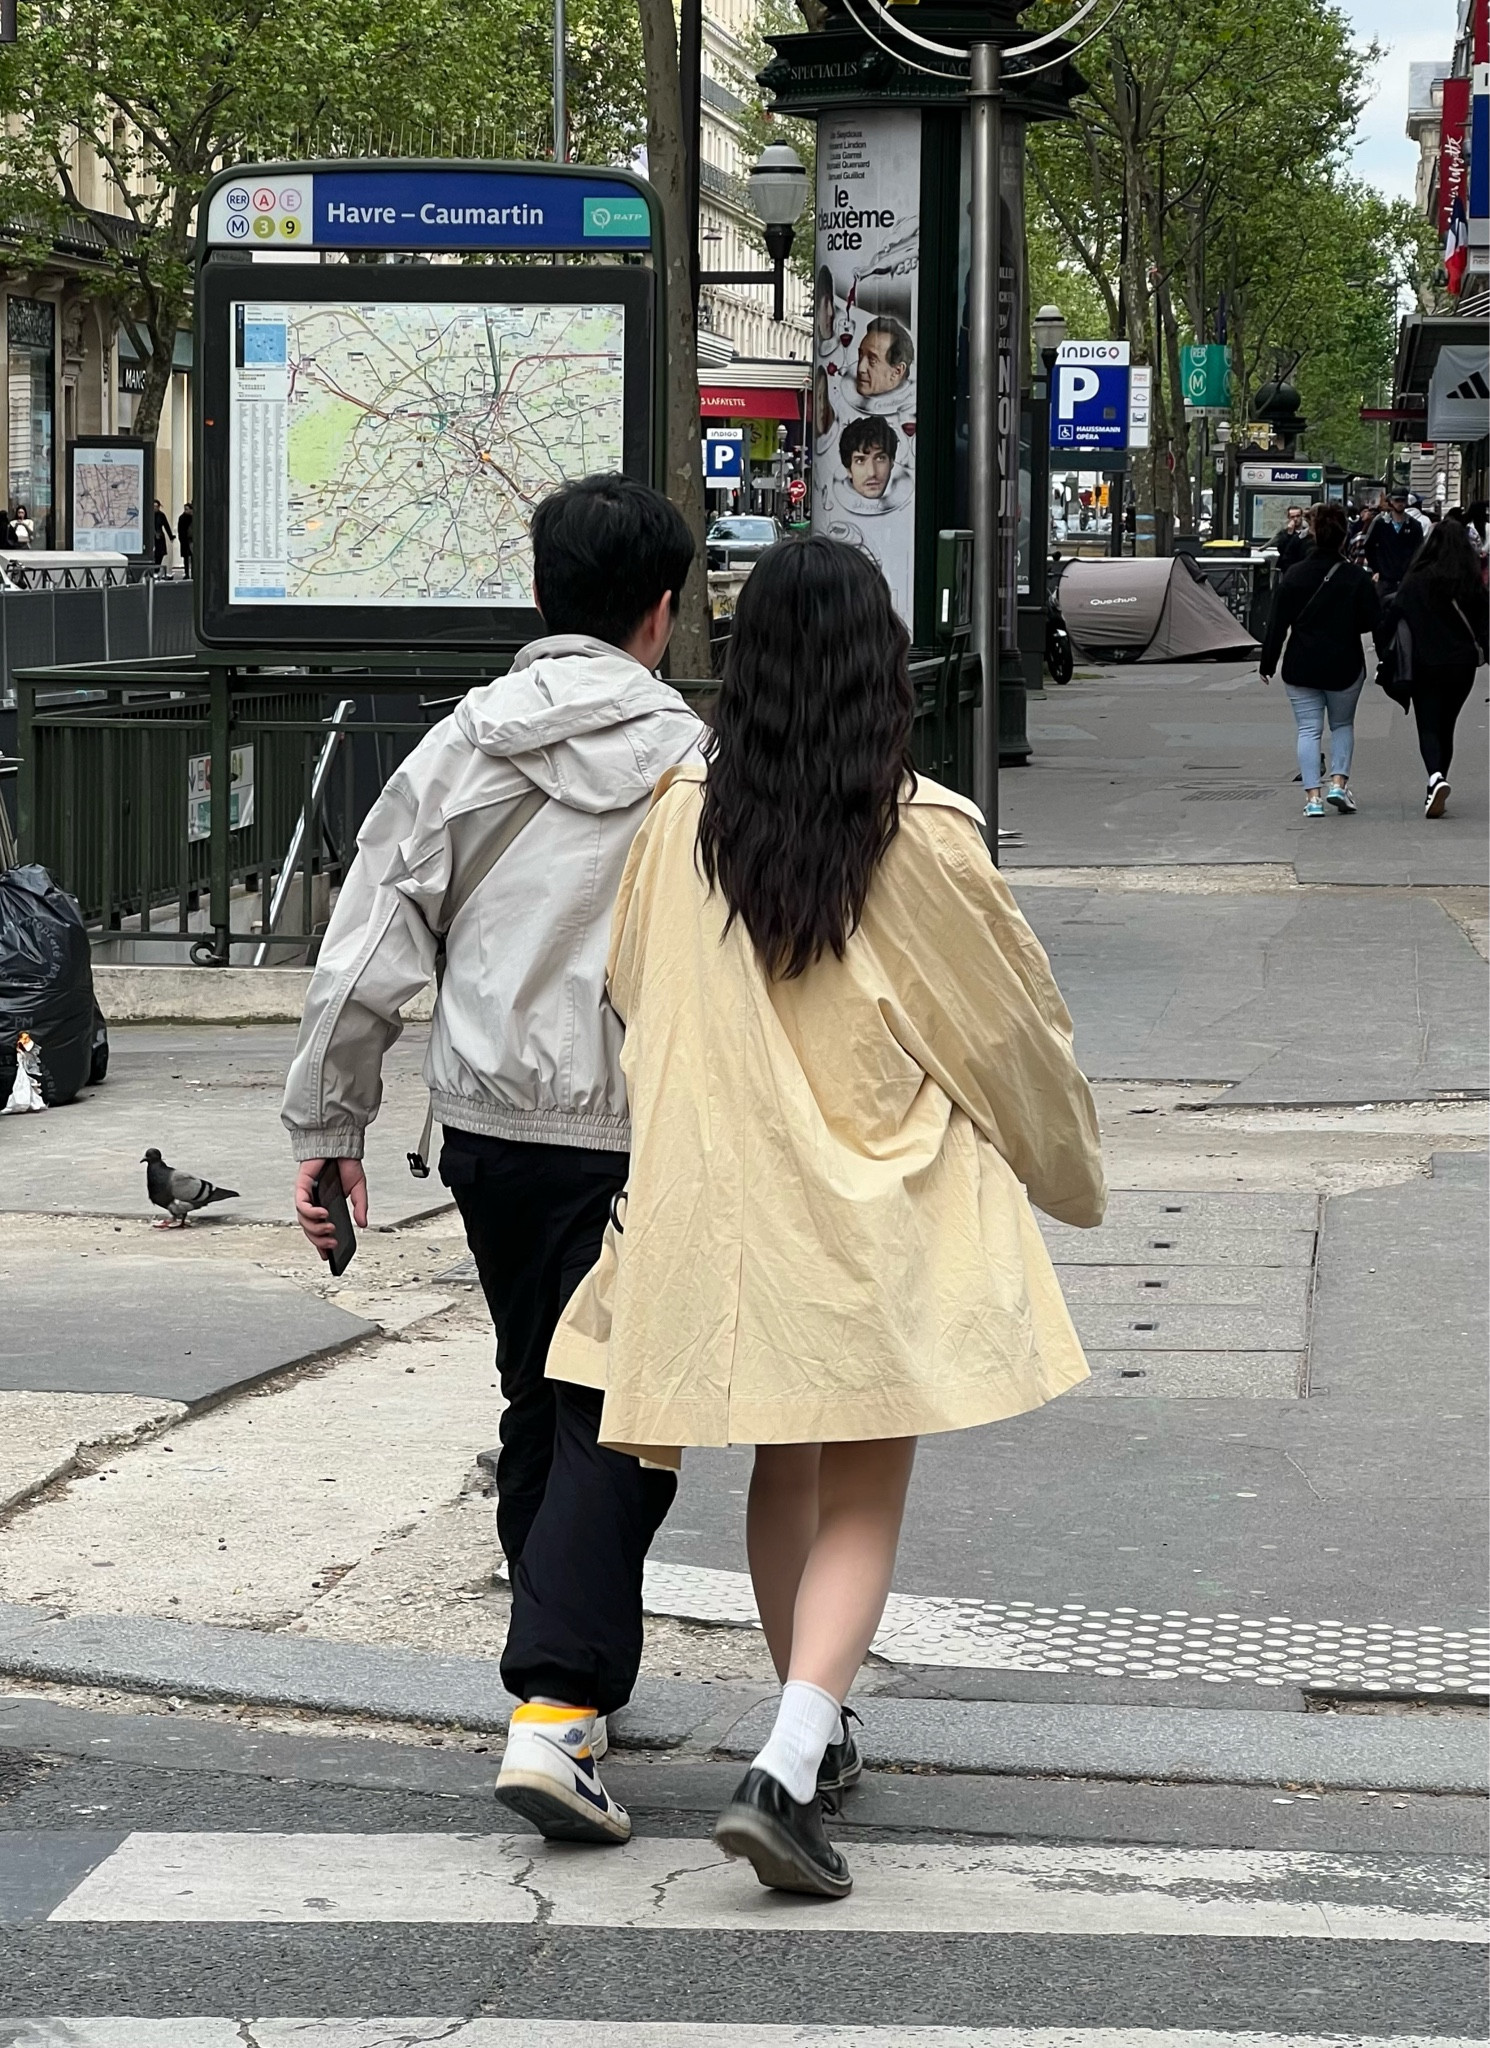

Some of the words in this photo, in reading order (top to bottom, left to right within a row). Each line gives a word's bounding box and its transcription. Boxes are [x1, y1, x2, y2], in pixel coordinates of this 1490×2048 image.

[790, 61, 857, 80] SPECTACLES
[230, 195, 247, 205] RER
[834, 184, 849, 208] le
[327, 202, 396, 224] Havre
[420, 203, 543, 225] Caumartin
[613, 213, 643, 221] RATP
[827, 230, 862, 251] acte
[1192, 374, 1204, 390] M
[1058, 366, 1100, 419] P
[706, 397, 746, 407] LAFAYETTE
[714, 445, 735, 470] P
[1274, 471, 1299, 480] Auber
[1089, 596, 1137, 606] Quechua
